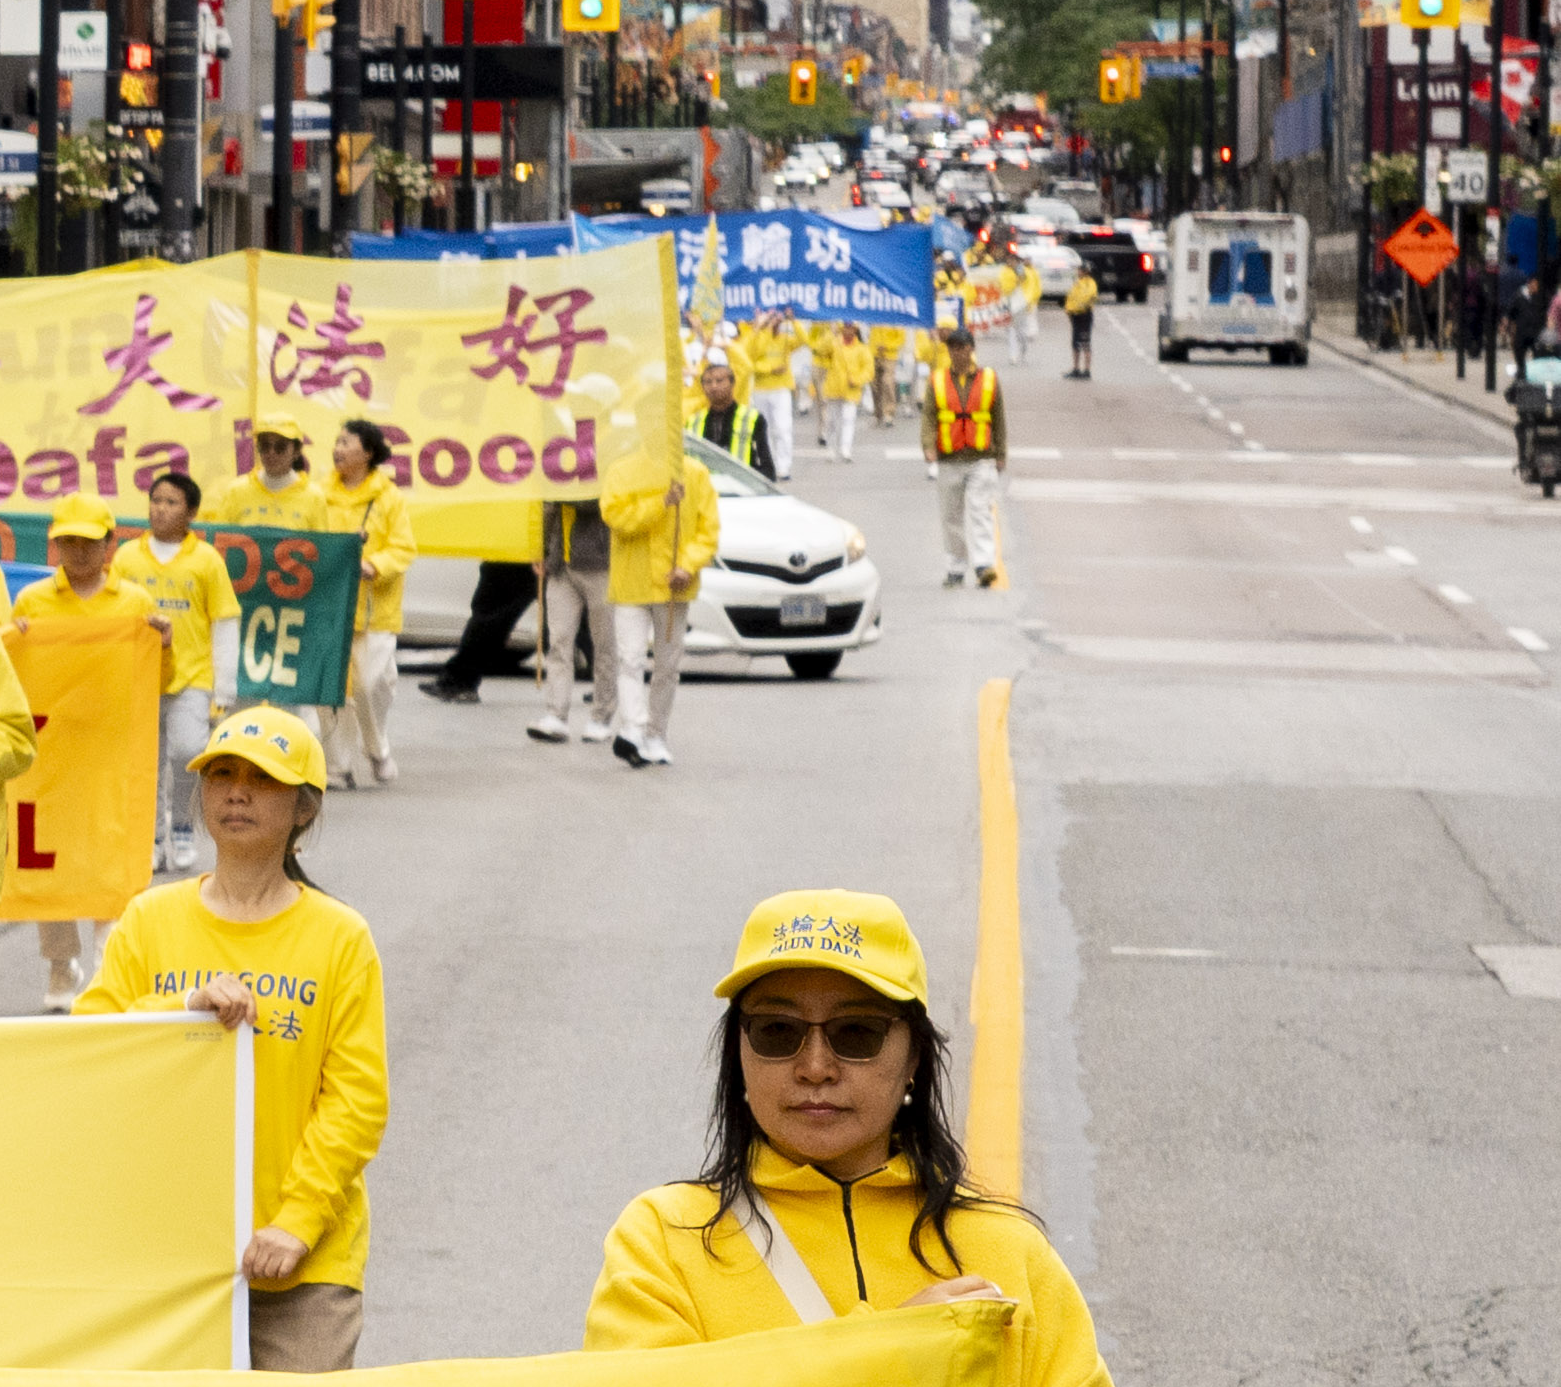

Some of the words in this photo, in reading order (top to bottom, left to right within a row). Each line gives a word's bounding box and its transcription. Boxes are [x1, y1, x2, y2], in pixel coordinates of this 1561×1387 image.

[1452, 175, 1484, 195] 40
[760, 276, 821, 311] Gong
[824, 278, 848, 306] in
[851, 279, 920, 316] China
[820, 937, 863, 960] DAFA
